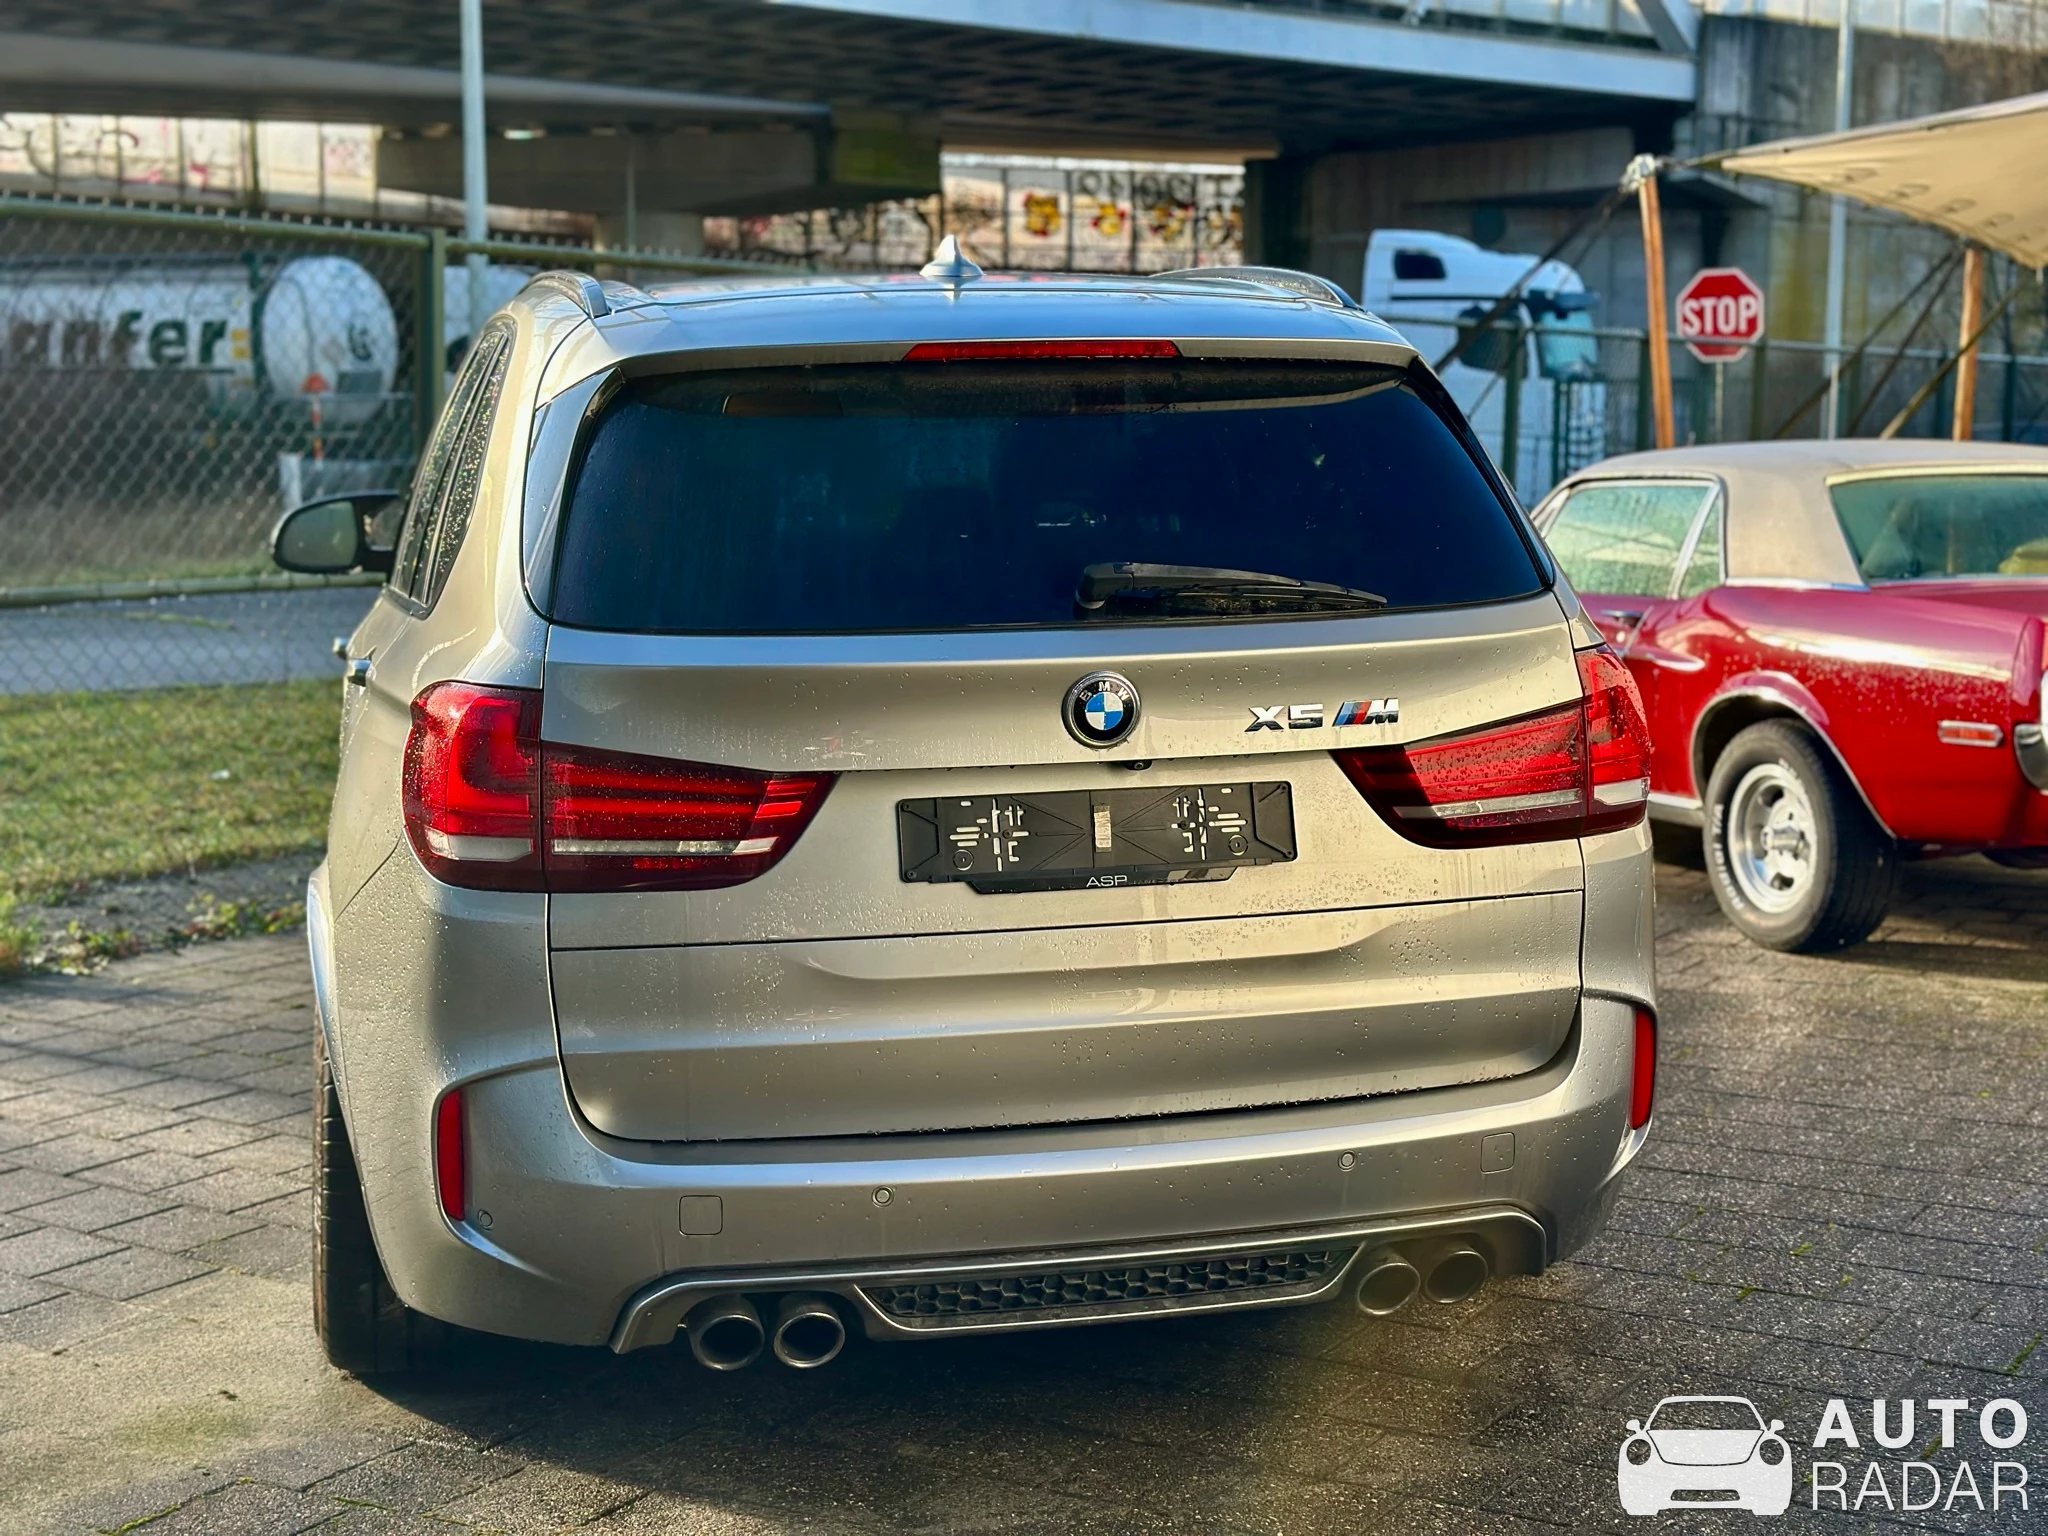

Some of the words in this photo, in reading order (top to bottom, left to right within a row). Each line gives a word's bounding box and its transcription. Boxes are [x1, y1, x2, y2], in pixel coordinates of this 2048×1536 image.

[1682, 294, 1757, 336] STOP
[1079, 680, 1131, 701] BMW
[1244, 703, 1324, 732] X5
[1085, 874, 1129, 888] ASP
